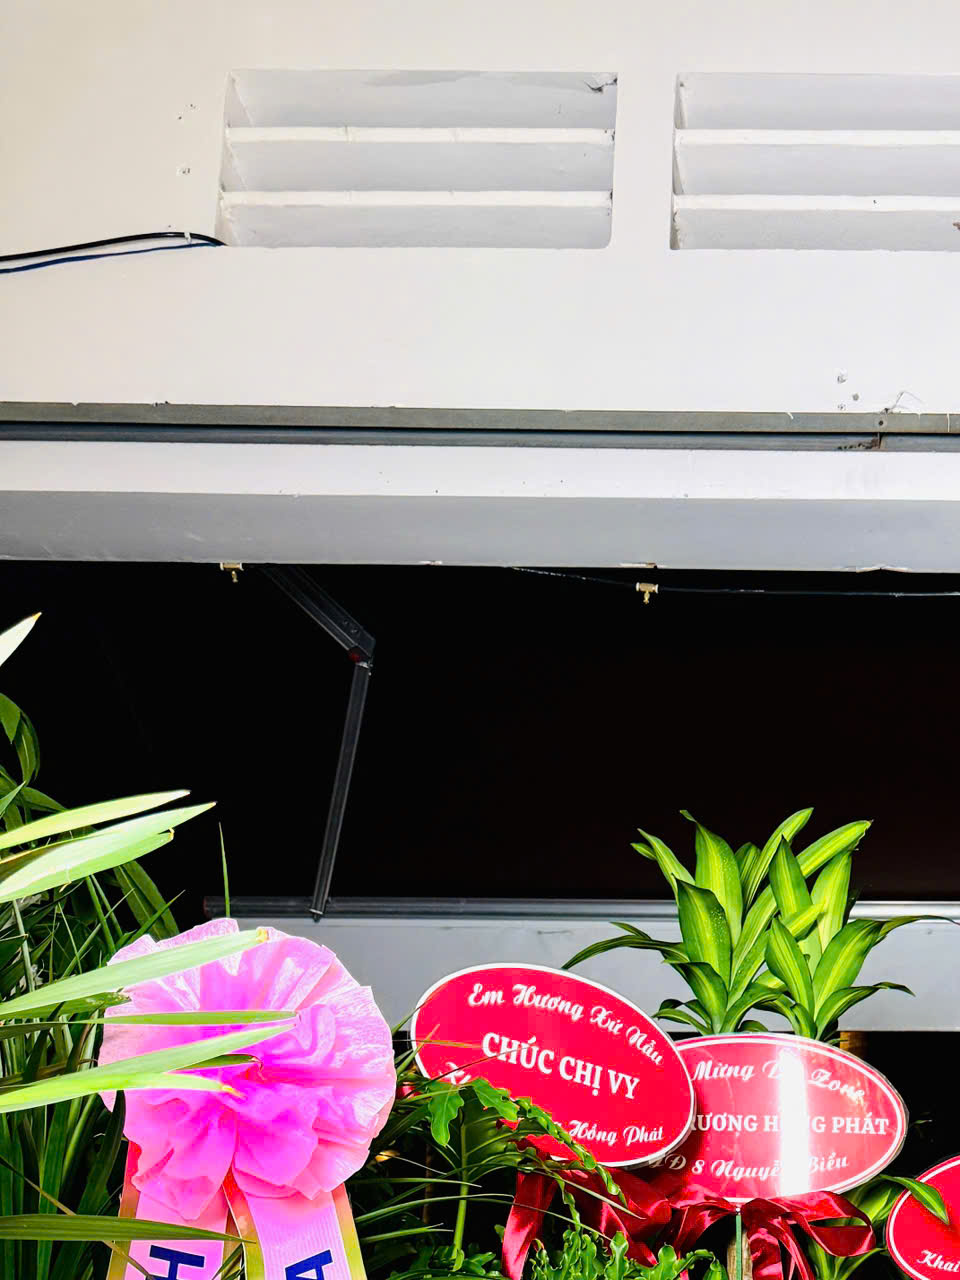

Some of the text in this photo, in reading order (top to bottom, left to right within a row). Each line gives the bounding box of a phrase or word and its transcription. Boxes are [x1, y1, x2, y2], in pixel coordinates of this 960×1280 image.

[467, 983, 505, 1007] Em
[512, 983, 585, 1022] Hương
[482, 1032, 555, 1075] CHÚC
[559, 1055, 603, 1096] CHỊ
[607, 1069, 641, 1100] VY
[690, 1112, 758, 1133] ƯƠNG
[831, 1111, 890, 1135] PHÁT
[622, 1125, 664, 1147] Phát
[691, 1160, 705, 1174] 8
[711, 1159, 784, 1181] Nguyễ
[916, 1249, 960, 1273] Khai
